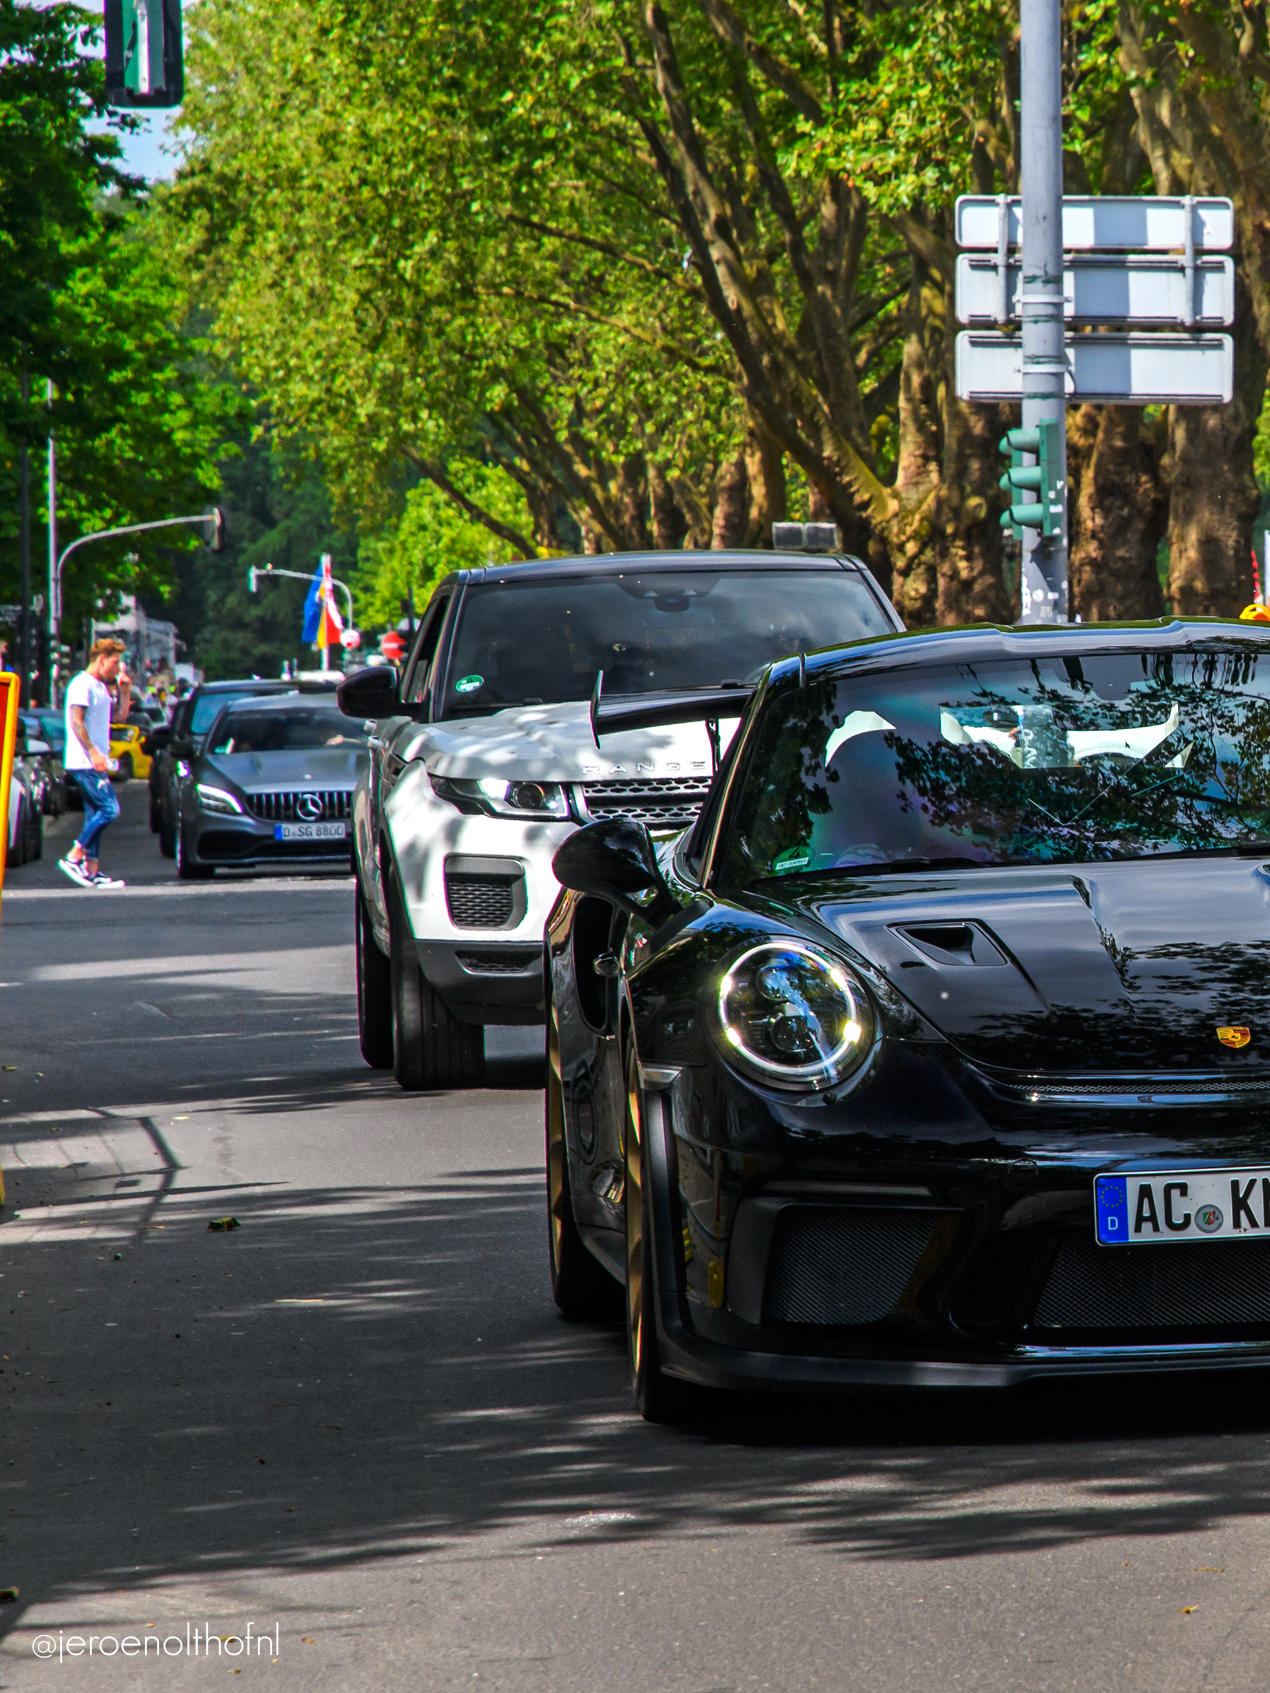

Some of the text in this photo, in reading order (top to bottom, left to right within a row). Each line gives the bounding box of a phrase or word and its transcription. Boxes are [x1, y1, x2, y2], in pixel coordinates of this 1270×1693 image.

[582, 761, 706, 775] RANGE
[1134, 1182, 1191, 1234] AC
[1107, 1216, 1119, 1231] D
